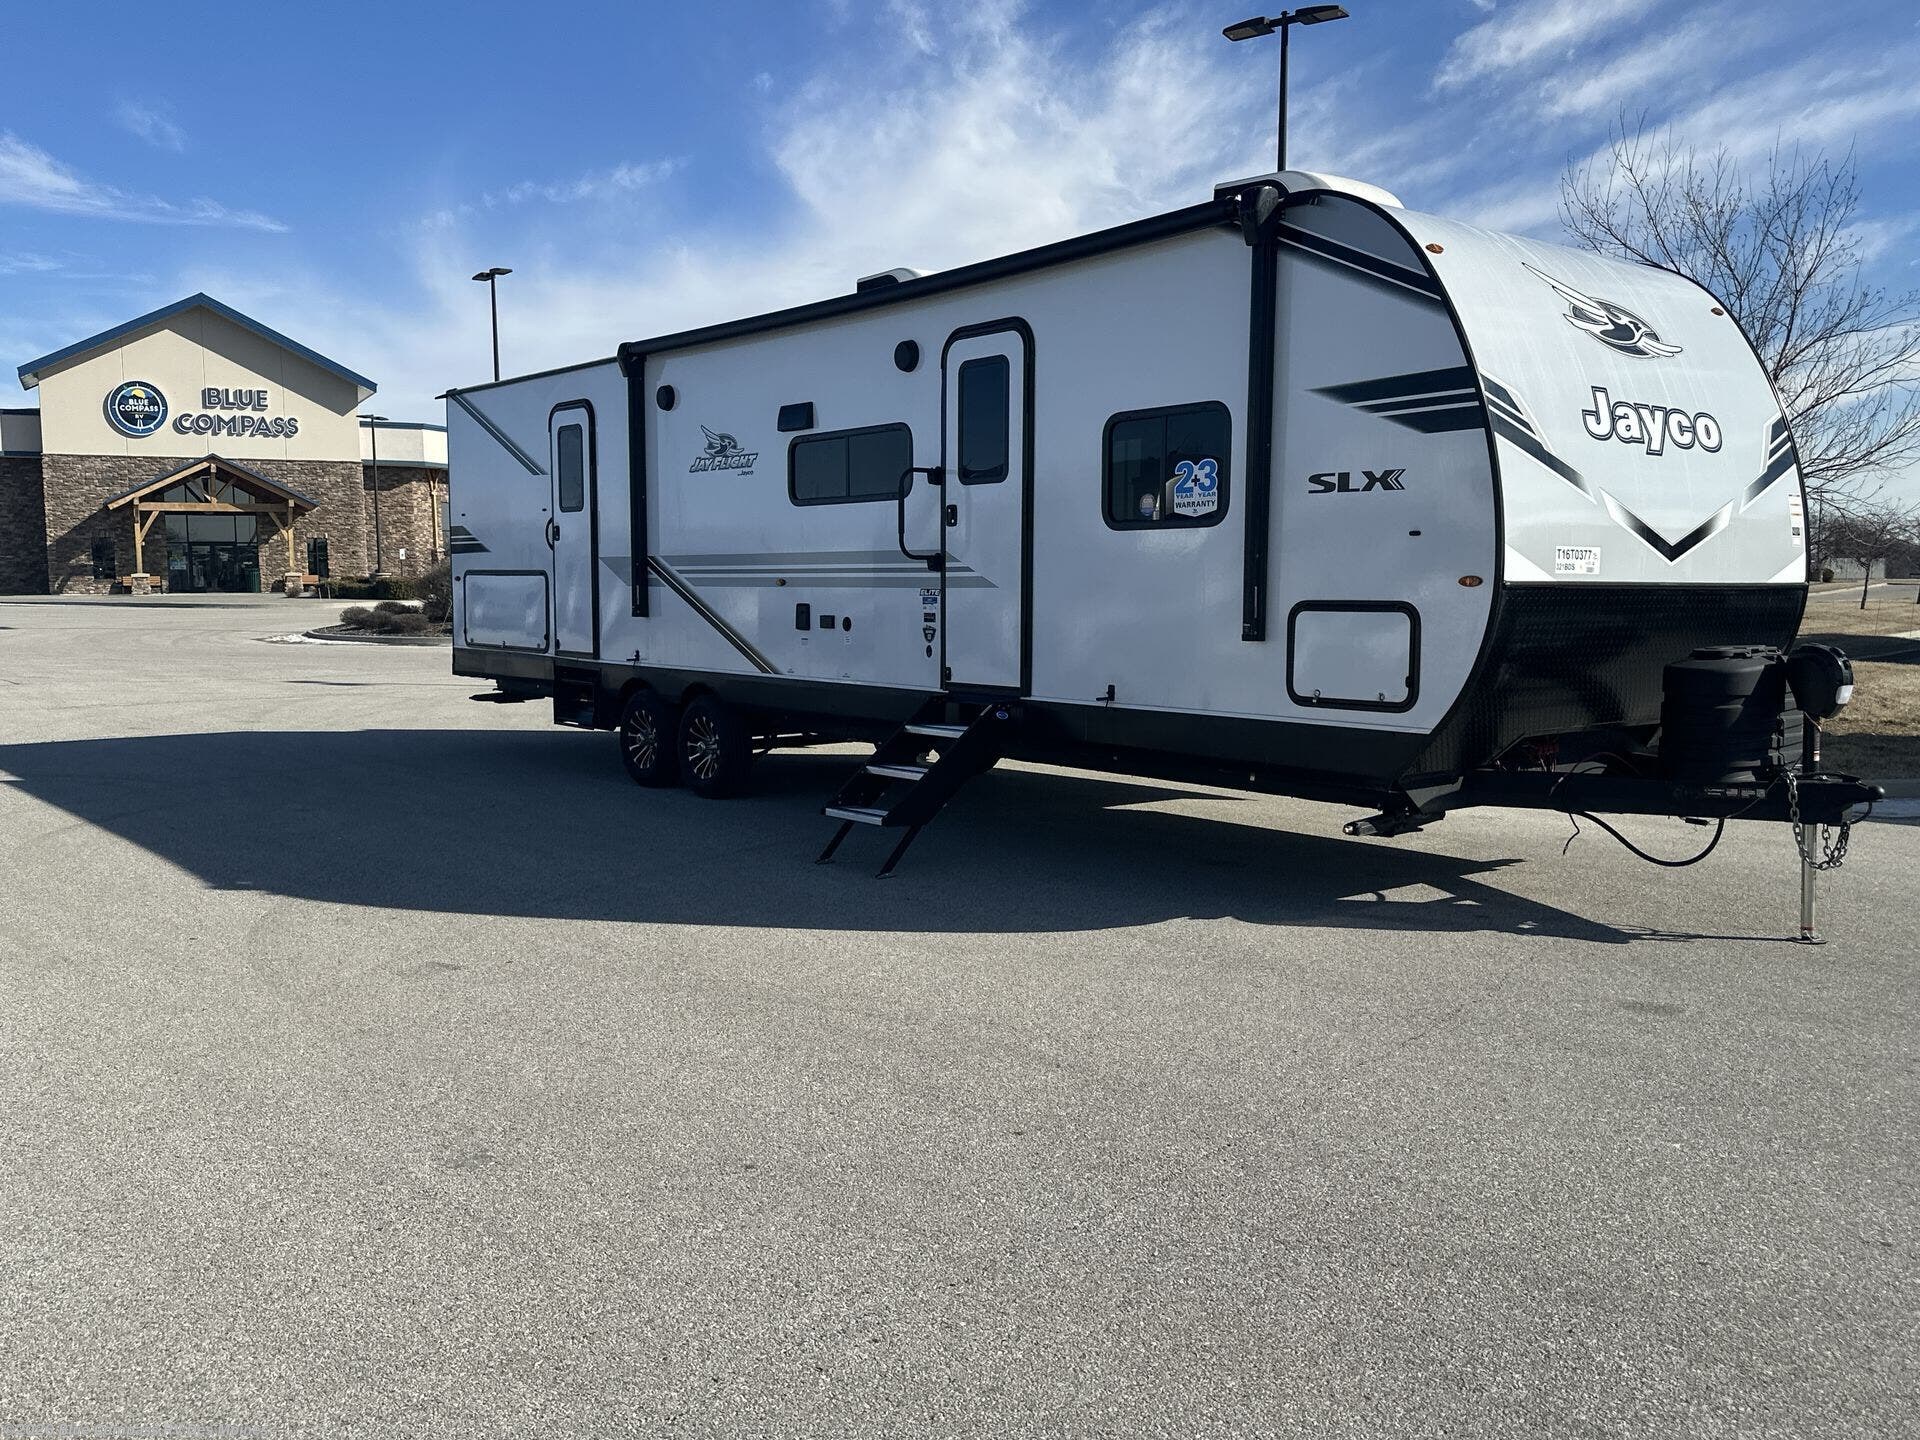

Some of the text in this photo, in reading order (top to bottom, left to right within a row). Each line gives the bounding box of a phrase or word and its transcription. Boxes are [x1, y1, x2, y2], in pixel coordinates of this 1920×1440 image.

[119, 404, 159, 412] COMPASS
[128, 398, 149, 406] BLUE
[201, 387, 268, 411] BLUE
[172, 413, 299, 438] COMPASS
[1582, 385, 1722, 456] Jayco
[689, 453, 758, 473] JAY FLIGHT
[1308, 468, 1407, 494] SLX
[1175, 500, 1216, 508] WARRANTY
[1557, 548, 1592, 560] T16T0377
